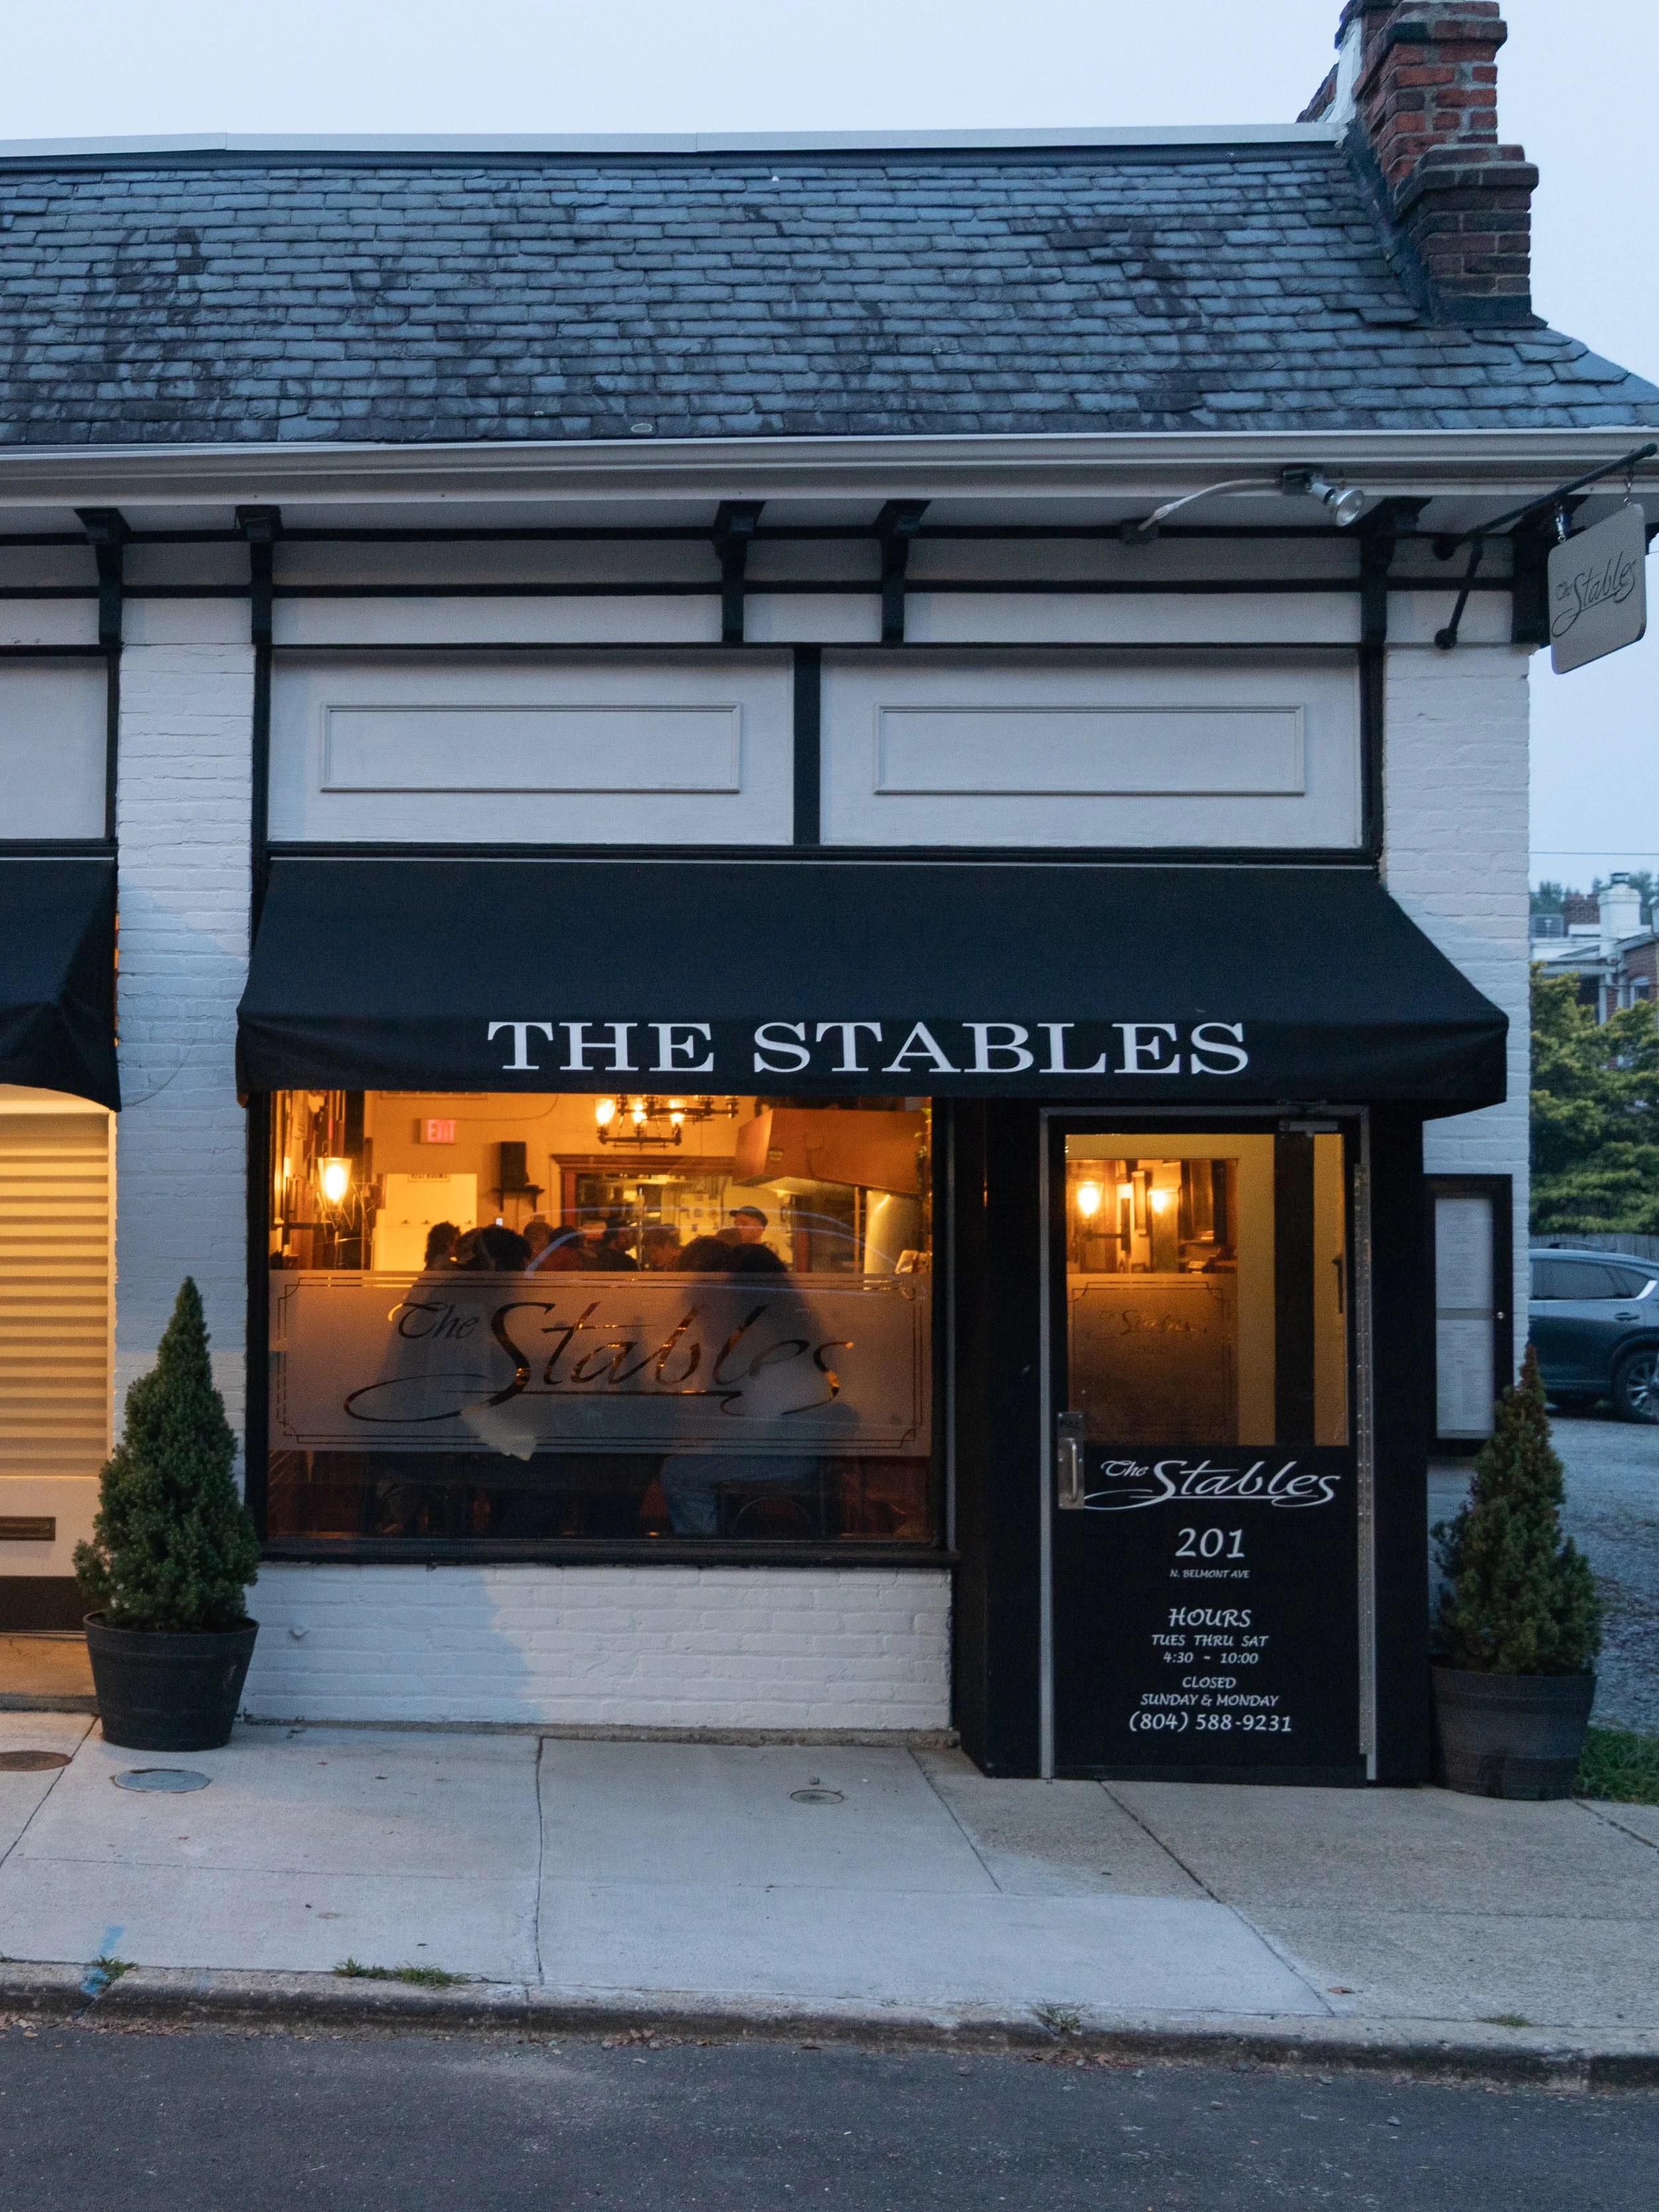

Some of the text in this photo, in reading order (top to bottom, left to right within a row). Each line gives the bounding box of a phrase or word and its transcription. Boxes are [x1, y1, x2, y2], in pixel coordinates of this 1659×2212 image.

[1551, 551, 1636, 637] Stables
[487, 1021, 1249, 1075] THE STABLES
[427, 1119, 457, 1142] EXIT
[344, 1301, 855, 1423] The Stables
[1084, 1459, 1341, 1511] The Stables
[1175, 1527, 1246, 1559] 201
[1183, 1569, 1230, 1578] BELMONT
[1230, 1570, 1250, 1578] AVE
[1168, 1607, 1252, 1628] HOURS
[1151, 1634, 1270, 1647] TUES THRU SAT
[1163, 1651, 1194, 1664] 4:30
[1220, 1652, 1259, 1664] 10:00
[1182, 1676, 1237, 1689] CLOSED
[1140, 1693, 1280, 1707] SUNDAY & MONDAY
[1129, 1711, 1292, 1733] (804) 588-9231
